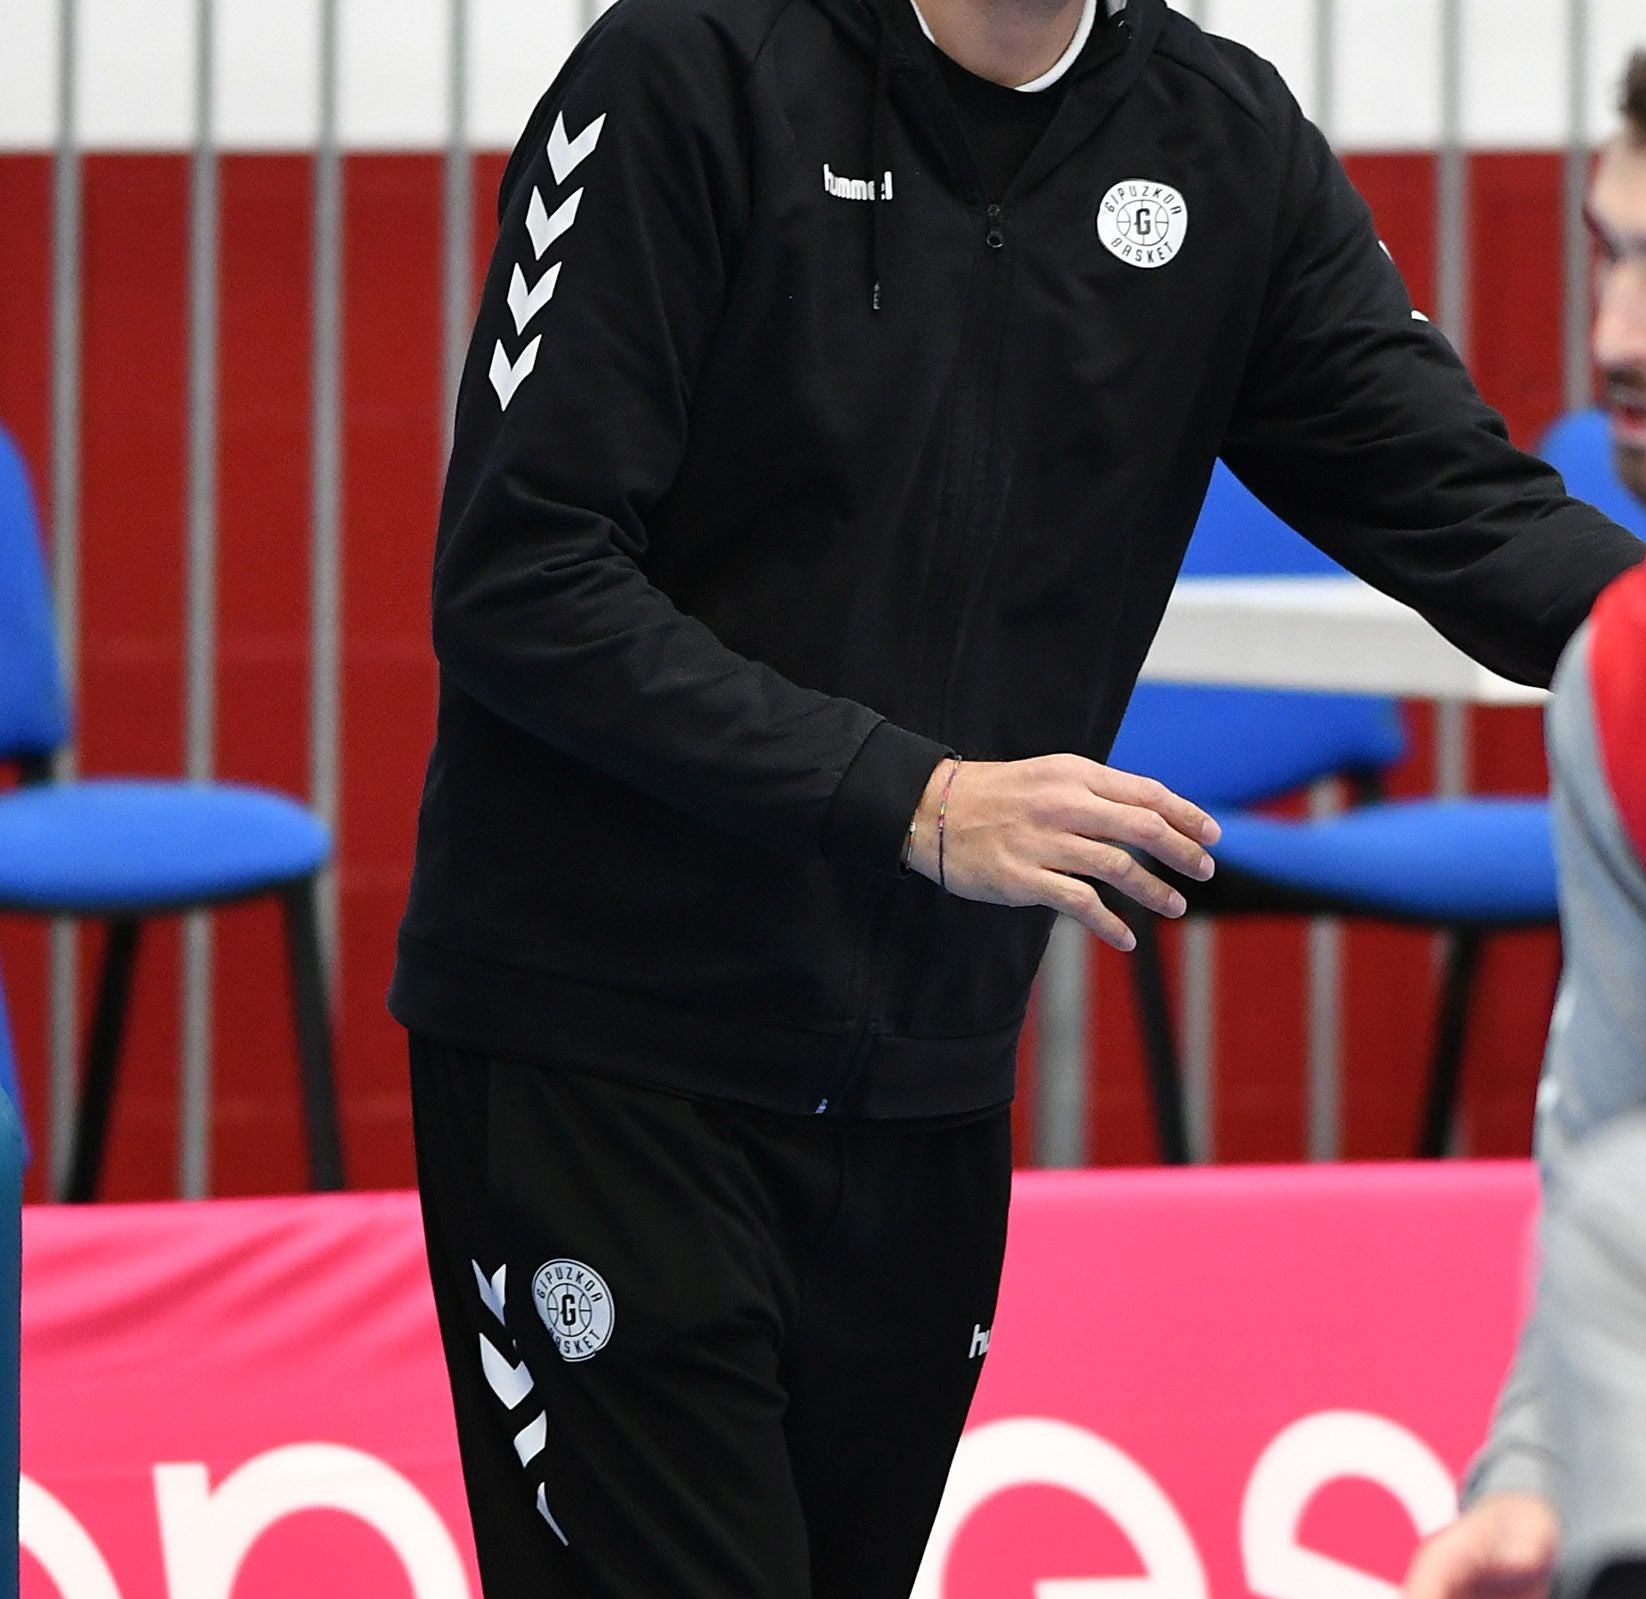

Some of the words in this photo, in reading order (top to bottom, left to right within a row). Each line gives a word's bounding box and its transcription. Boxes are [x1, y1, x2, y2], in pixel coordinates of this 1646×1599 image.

[1104, 185, 1182, 215] GIPUZKOA
[1134, 207, 1151, 236] G
[1110, 237, 1173, 263] BASKET
[536, 1266, 604, 1303] GIPUZKOA
[560, 1294, 577, 1326] G
